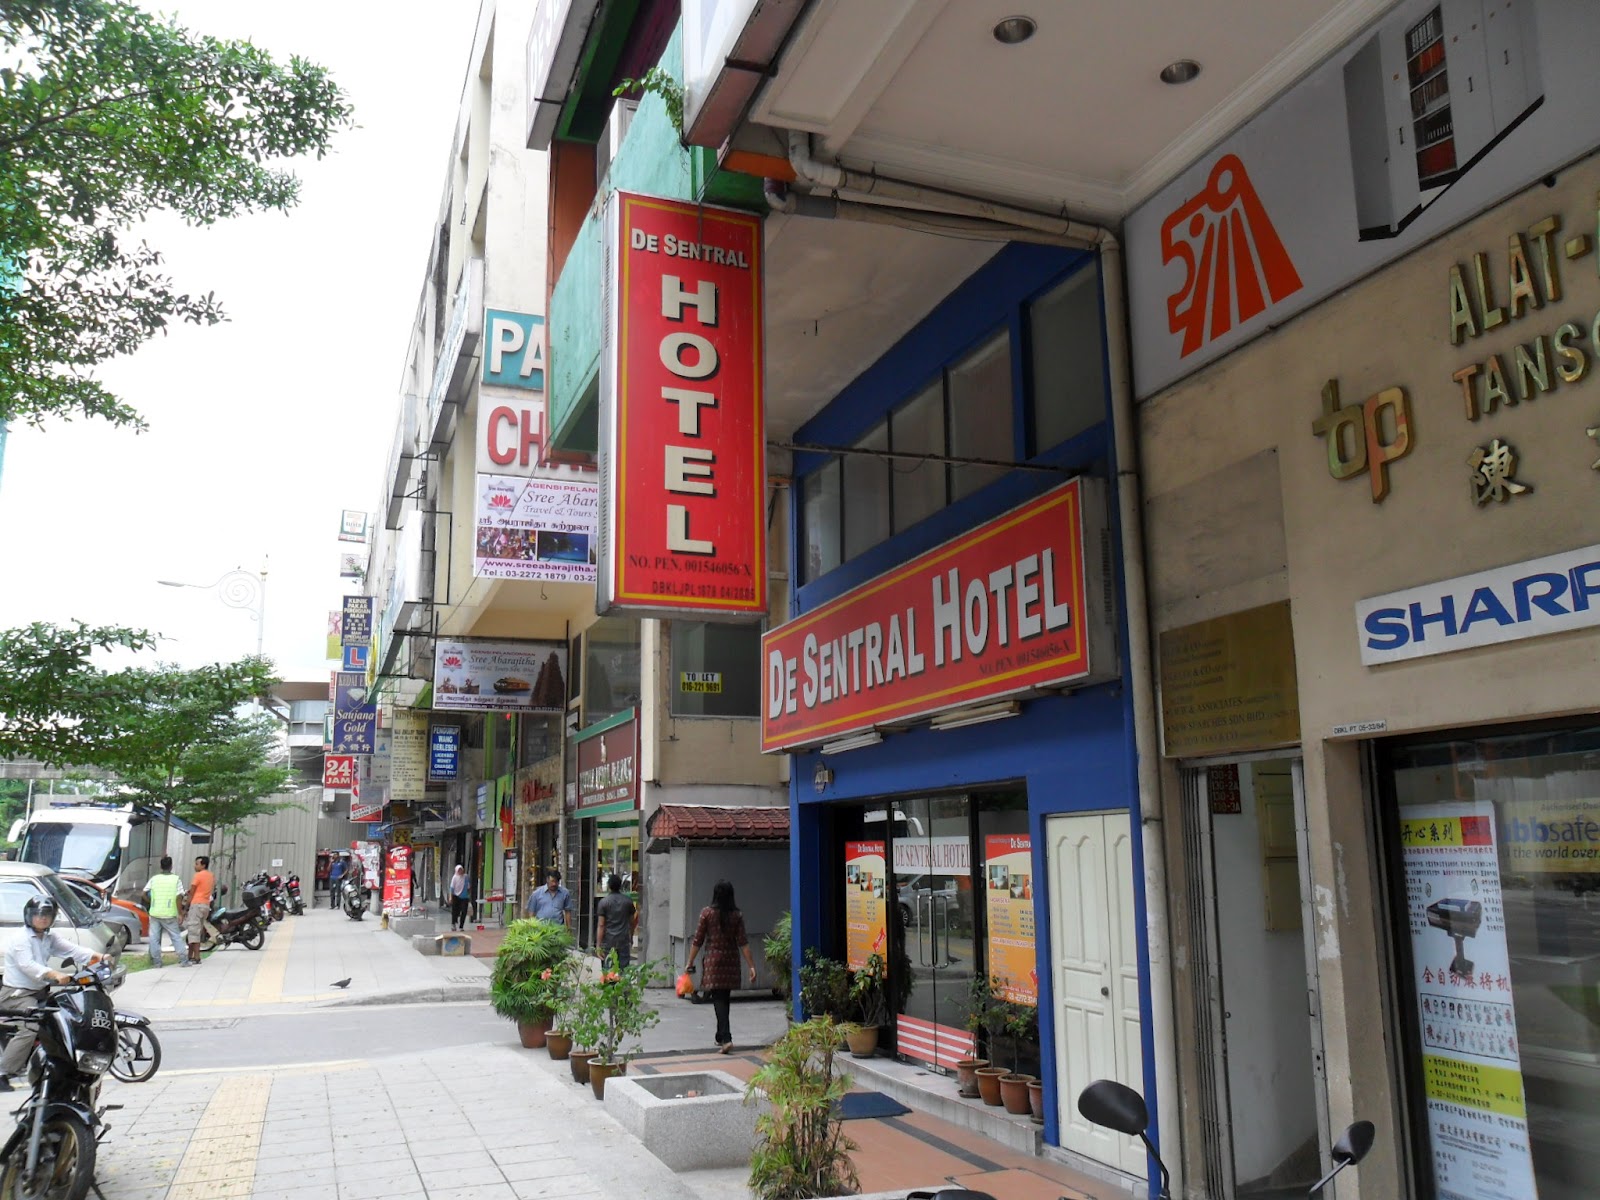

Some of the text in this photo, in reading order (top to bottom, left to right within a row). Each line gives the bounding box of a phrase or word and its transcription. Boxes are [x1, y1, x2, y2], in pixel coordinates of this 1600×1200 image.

[631, 227, 749, 268] DE SENTRAL
[1449, 214, 1600, 346] ALAT-
[659, 274, 718, 555] HOTEL
[526, 483, 562, 491] AGENSI
[523, 490, 555, 503] Sree
[523, 505, 552, 514] Travel
[566, 508, 592, 518] Tours
[505, 570, 542, 578] 03-2272
[544, 572, 566, 580] 1879
[1364, 561, 1600, 650] SHARP
[769, 547, 1069, 720] DE SENTRAL HOTEL
[686, 672, 696, 681] TO
[343, 722, 367, 733] Gold
[326, 759, 351, 776] 24
[326, 776, 350, 785] JAM
[1401, 822, 1454, 842] 开心系列
[895, 844, 970, 868] DE SENTRAL HOTEL
[1513, 846, 1531, 858] the
[1535, 845, 1569, 858] world
